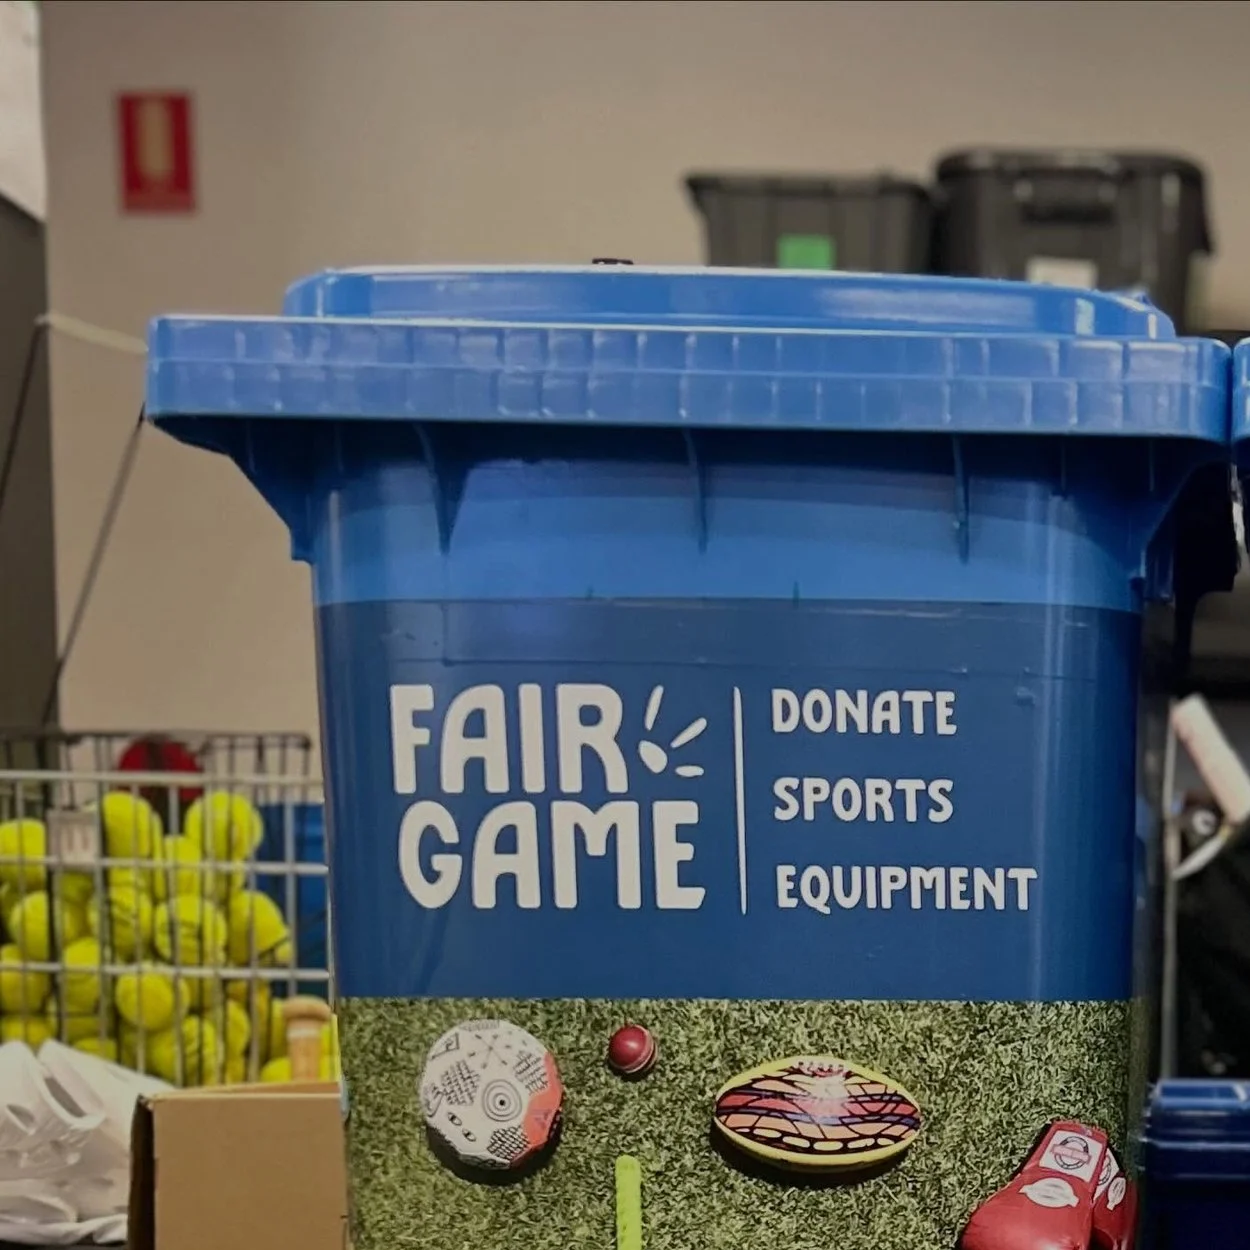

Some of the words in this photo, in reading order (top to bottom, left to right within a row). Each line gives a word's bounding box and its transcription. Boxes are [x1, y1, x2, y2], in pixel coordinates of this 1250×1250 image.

[773, 689, 956, 735] DONATE
[391, 684, 627, 793] FAIR
[774, 778, 953, 822] SPORTS
[399, 801, 705, 909] GAME
[777, 866, 1038, 914] EQUIPMENT
